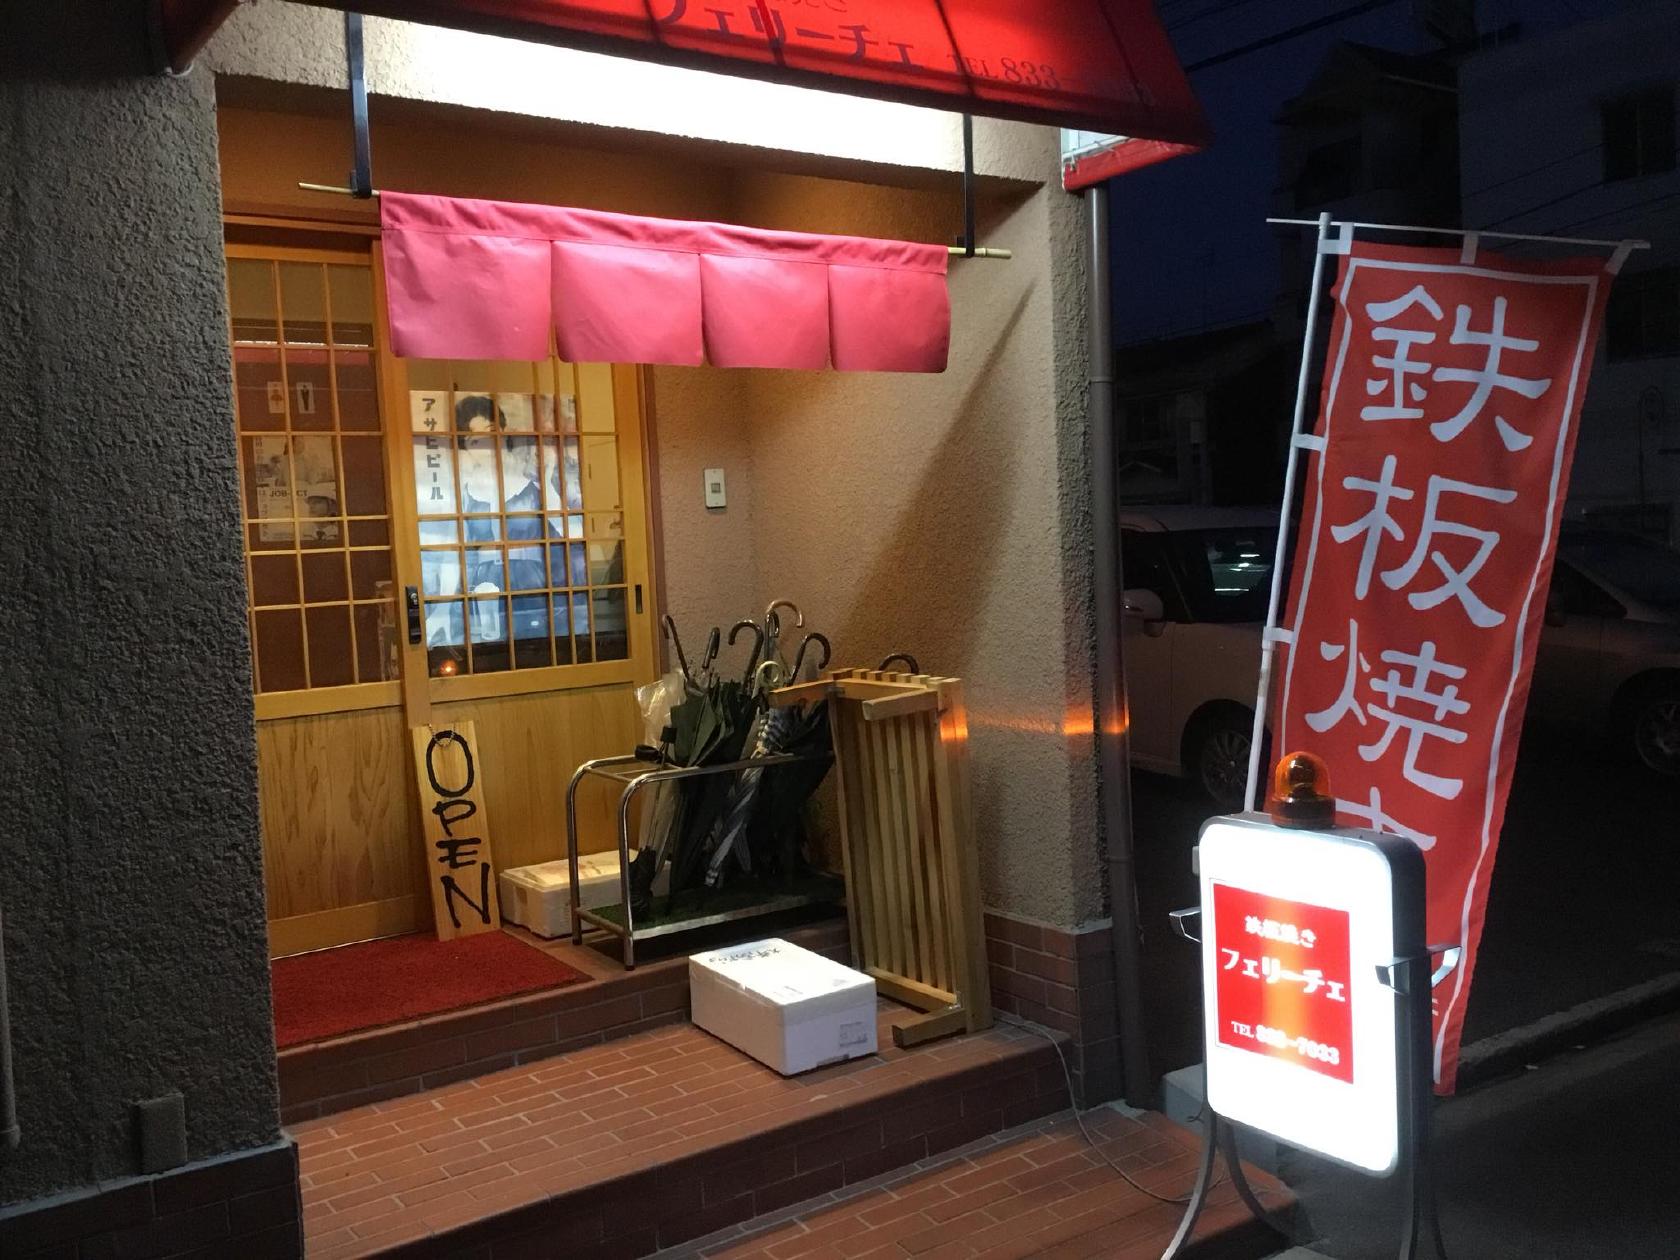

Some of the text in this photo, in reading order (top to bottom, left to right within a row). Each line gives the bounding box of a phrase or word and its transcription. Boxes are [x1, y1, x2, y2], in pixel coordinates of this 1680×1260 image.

[422, 398, 443, 500] アサヒビール
[426, 730, 490, 928] OPEN
[1221, 948, 1345, 1002] フェリーチェ
